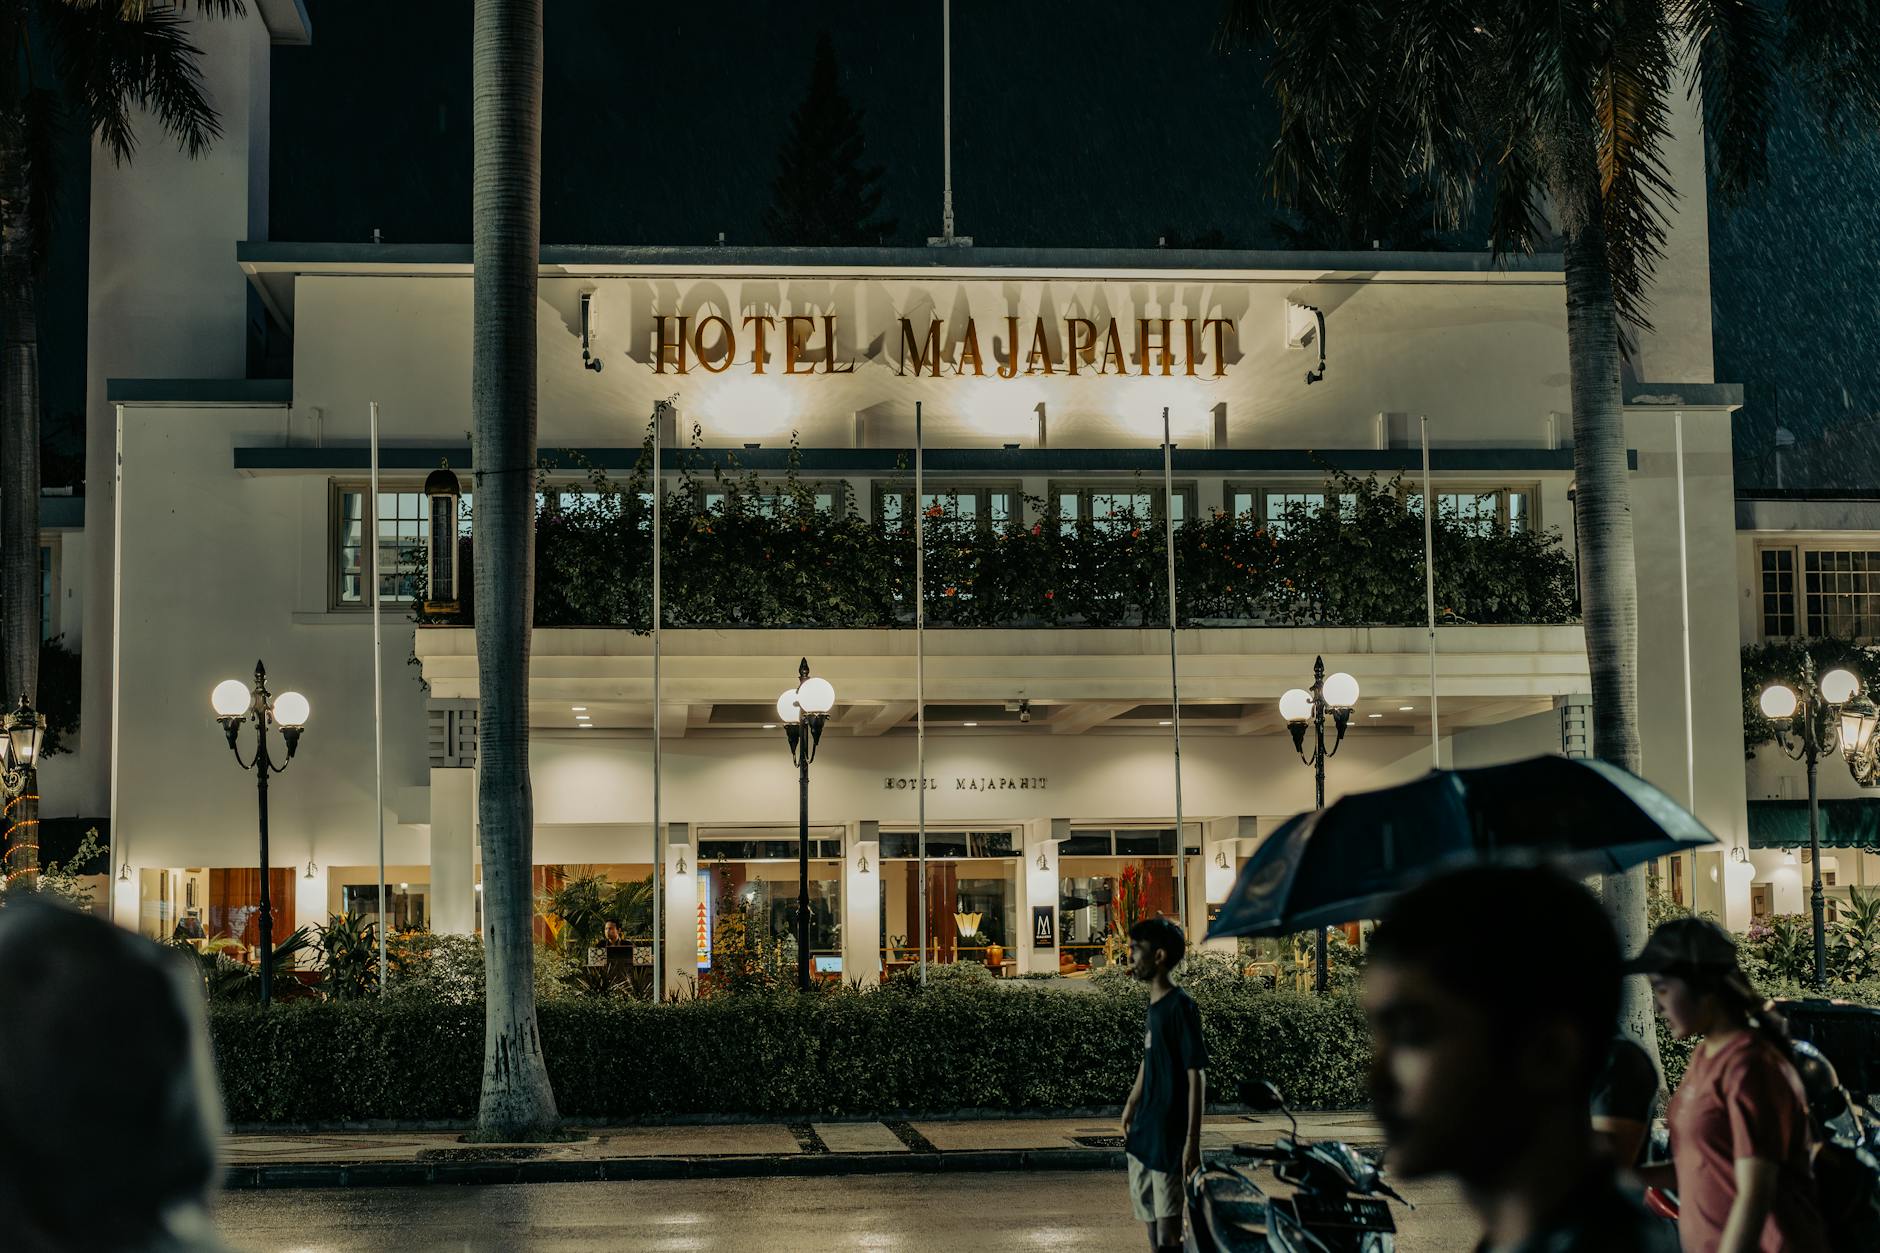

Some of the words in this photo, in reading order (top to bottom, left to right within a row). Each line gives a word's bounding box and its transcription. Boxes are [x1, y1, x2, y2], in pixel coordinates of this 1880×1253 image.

[652, 315, 856, 375] HOTEL
[894, 315, 1235, 379] MAJAPAHIT
[956, 778, 1048, 792] MAJAPAHIT
